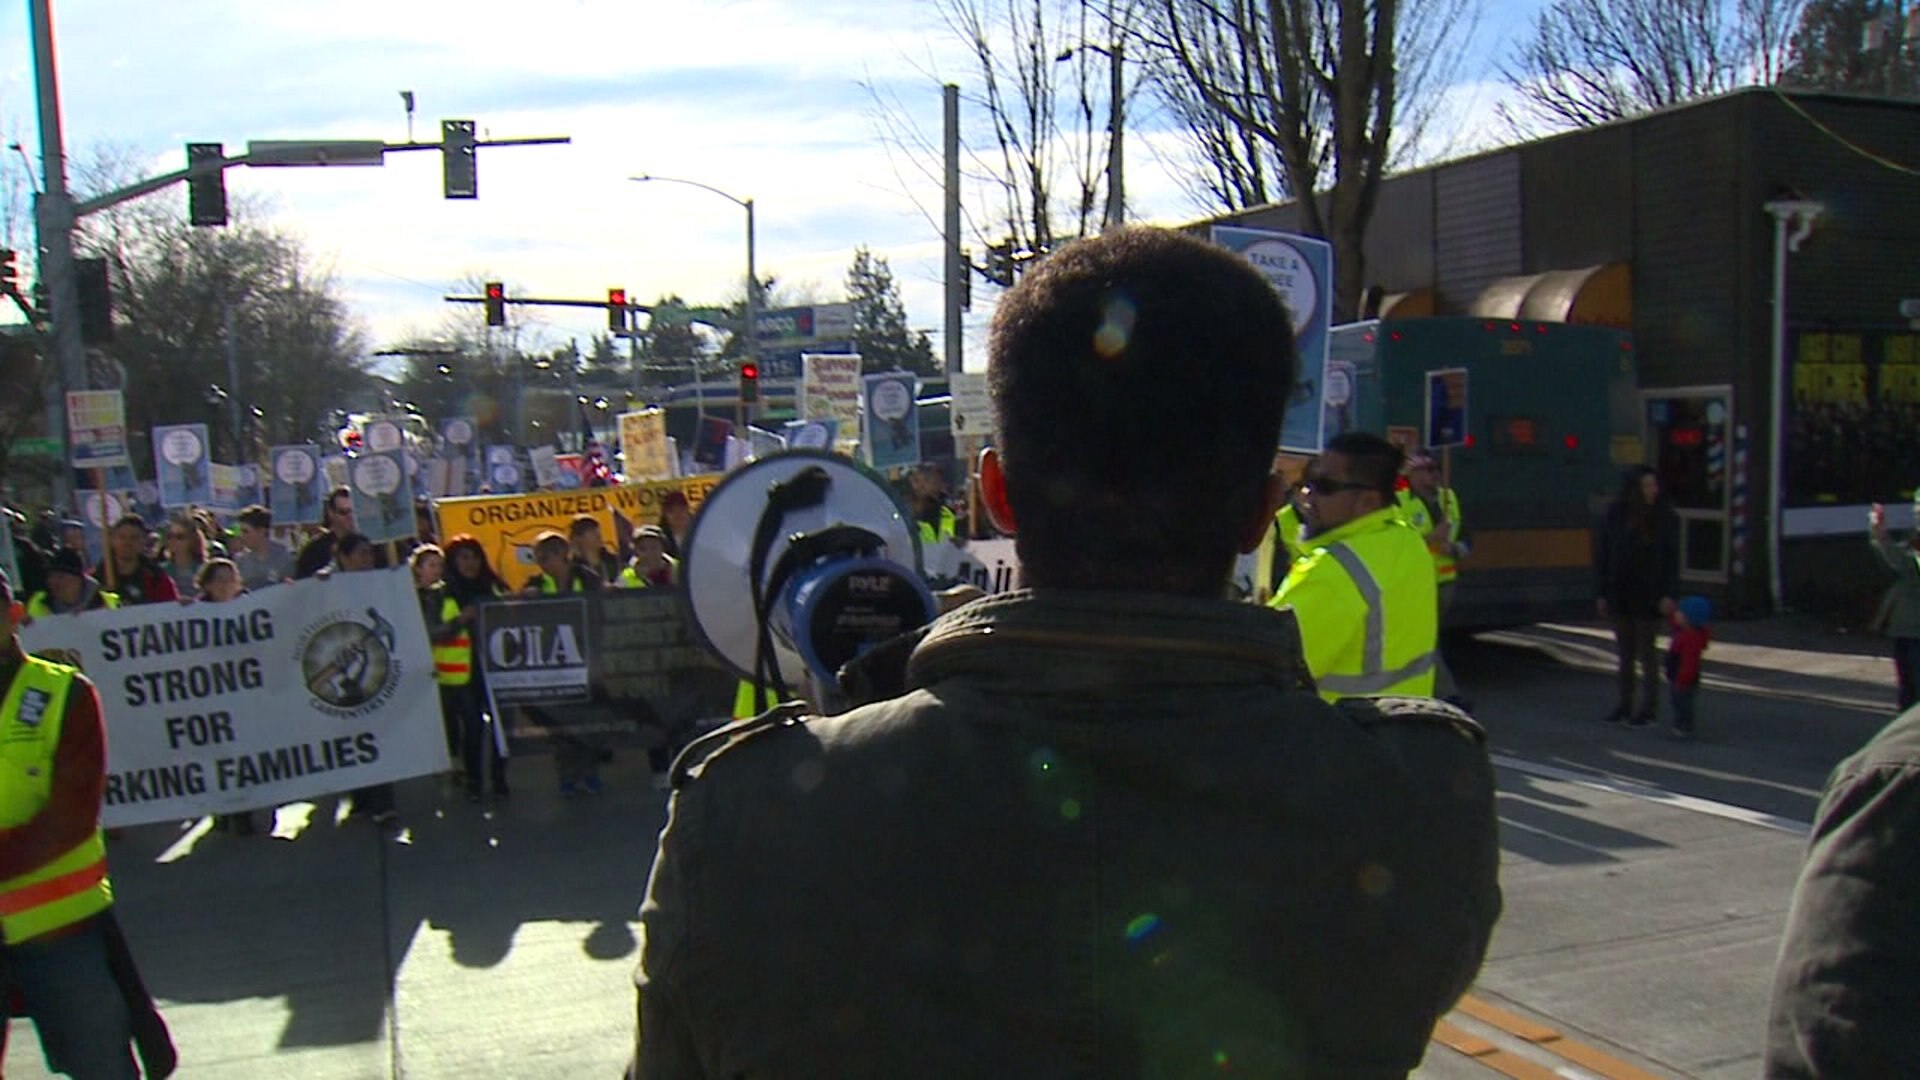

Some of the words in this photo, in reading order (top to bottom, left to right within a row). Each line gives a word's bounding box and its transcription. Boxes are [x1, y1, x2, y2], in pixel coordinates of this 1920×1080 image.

[1251, 253, 1287, 269] TAKE
[468, 493, 607, 526] ORGANIZED
[615, 481, 716, 508] WORER
[848, 576, 891, 592] PYLE
[101, 609, 274, 662] STANDING
[488, 624, 584, 671] CIA
[125, 657, 263, 707] STRONG
[167, 711, 236, 750] FOR
[105, 762, 206, 805] RKING
[217, 732, 380, 792] FAMILIES
